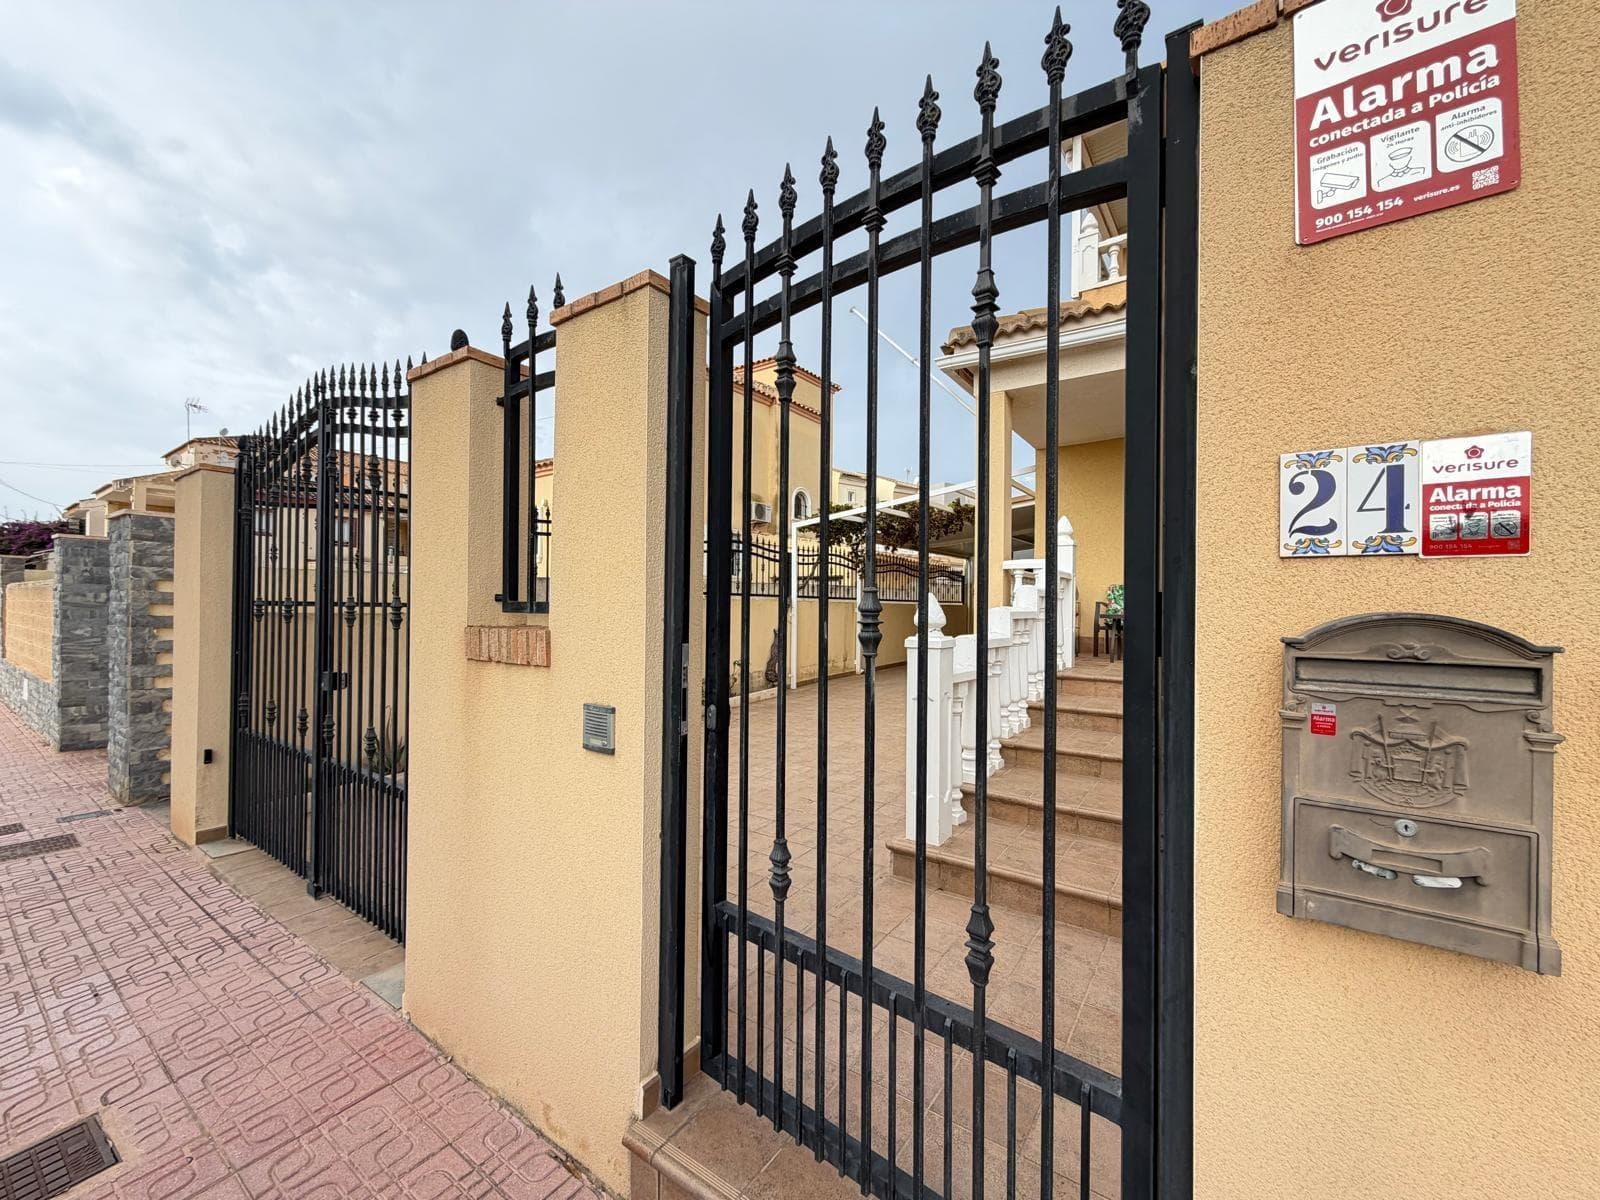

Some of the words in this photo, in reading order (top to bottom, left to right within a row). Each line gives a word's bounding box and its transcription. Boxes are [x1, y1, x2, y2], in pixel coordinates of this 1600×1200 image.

[1314, 0, 1488, 71] verisure
[1309, 44, 1499, 131] Alarma
[1309, 108, 1406, 147] conectada
[1411, 101, 1423, 114] a
[1429, 74, 1500, 108] Policía
[1451, 105, 1486, 121] Alarma
[1380, 127, 1420, 142] Vigilante
[1316, 146, 1359, 164] Grabación
[1315, 213, 1343, 229] 900
[1346, 205, 1373, 220] 154
[1376, 196, 1404, 212] 154
[1413, 183, 1461, 202] verisure.es
[1432, 459, 1519, 474] verisure
[1289, 463, 1414, 538] 24
[1429, 485, 1522, 503] Alarma
